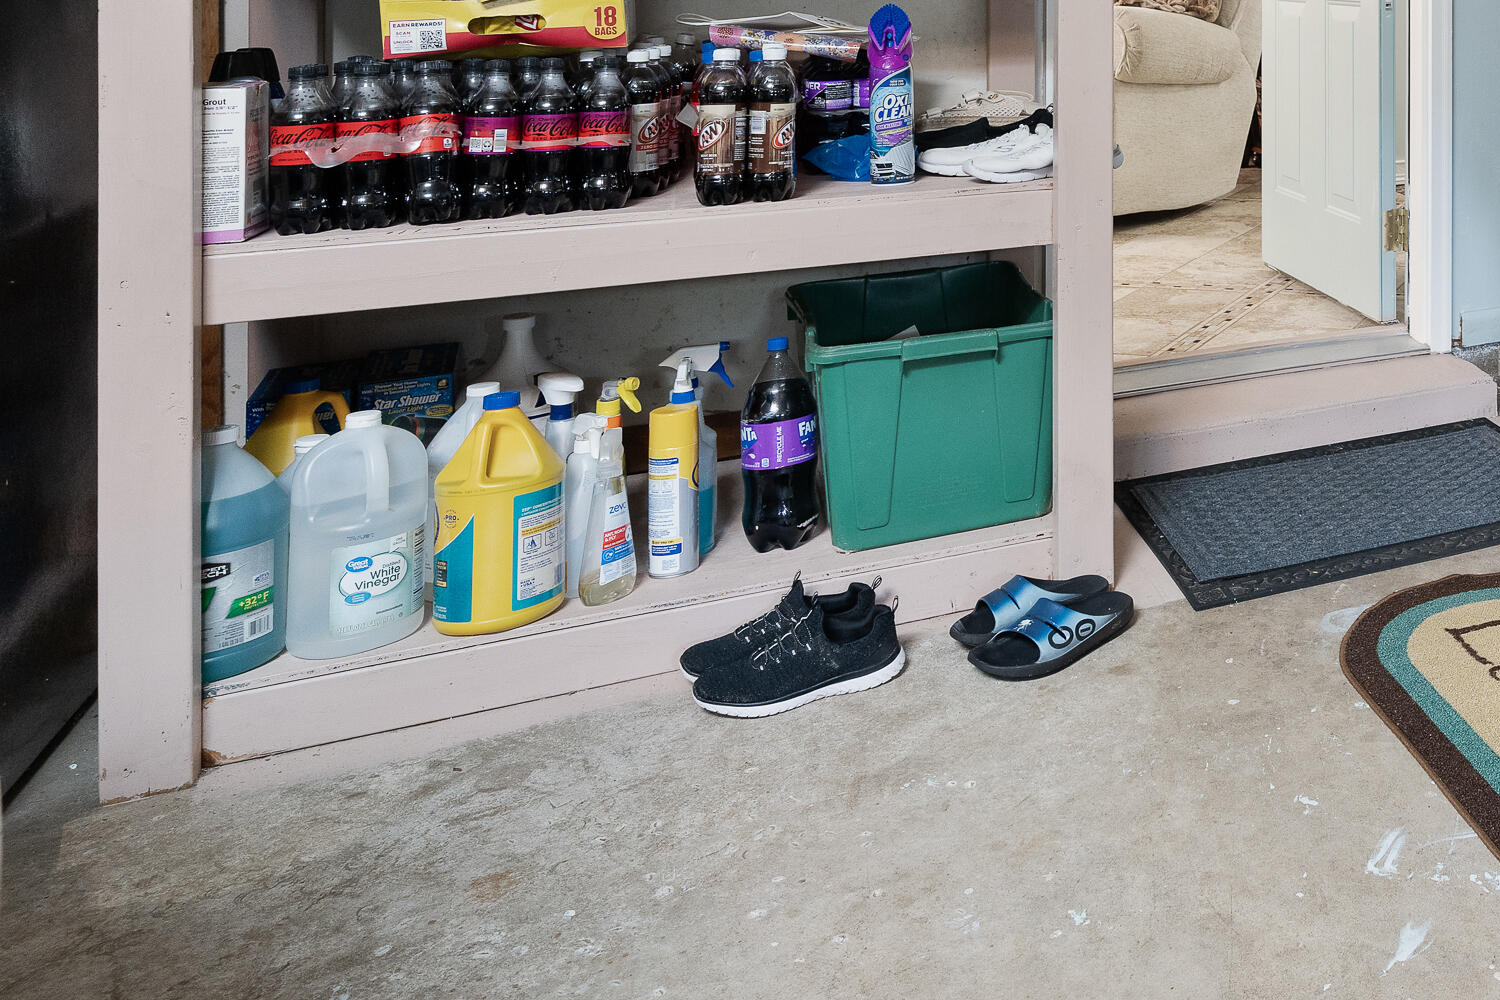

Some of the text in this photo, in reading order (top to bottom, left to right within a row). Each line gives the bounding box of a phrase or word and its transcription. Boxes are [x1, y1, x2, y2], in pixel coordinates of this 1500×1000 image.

[594, 6, 617, 27] 18
[594, 26, 618, 37] BAGS
[202, 98, 226, 106] Grout
[883, 93, 909, 109] OXI
[874, 102, 912, 124] CLEAN
[702, 118, 722, 148] A&W
[373, 392, 442, 410] Star Shower
[741, 426, 758, 442] NTA
[776, 426, 782, 436] ME
[370, 565, 401, 580] White
[354, 572, 401, 591] Vinegar
